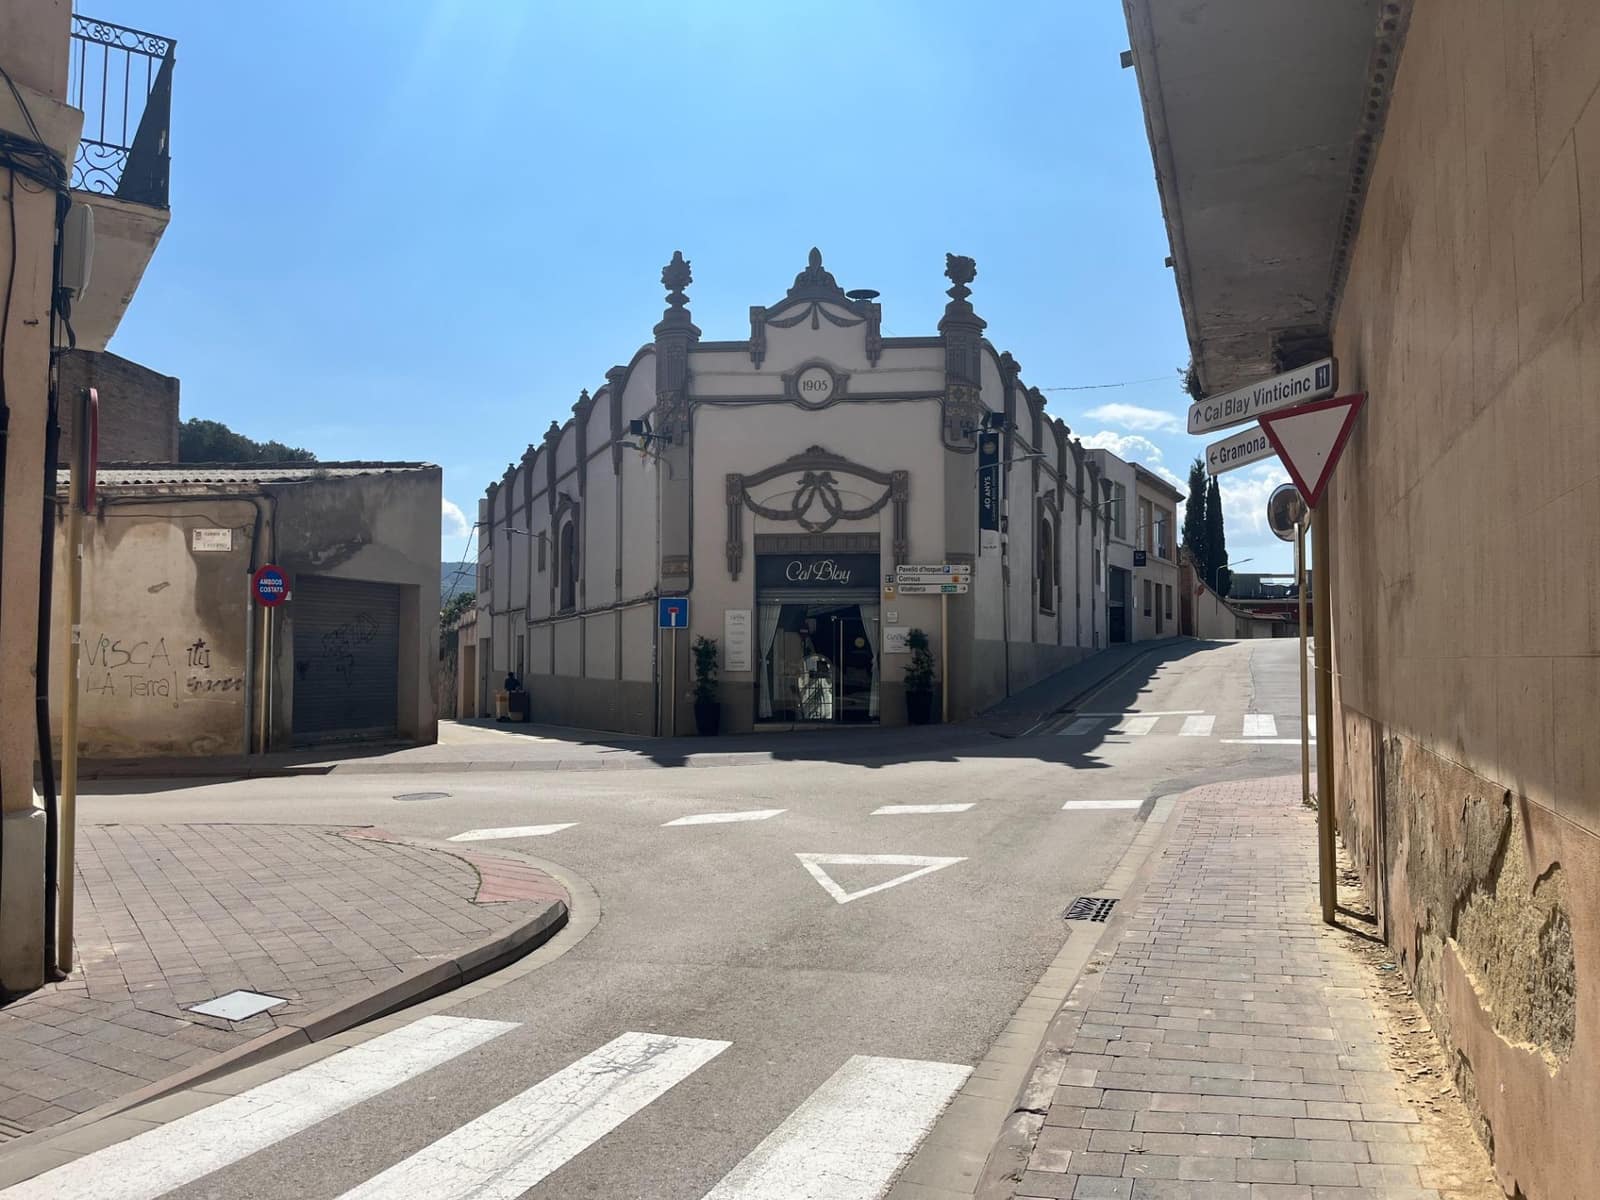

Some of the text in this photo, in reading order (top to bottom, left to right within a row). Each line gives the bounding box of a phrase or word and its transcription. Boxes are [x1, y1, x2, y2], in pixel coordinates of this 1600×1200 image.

[803, 380, 828, 391] 1905
[1204, 378, 1311, 422] Cal Blay Vinticinc
[1219, 436, 1266, 464] Gramona
[984, 497, 991, 510] 40
[786, 559, 851, 584] Cal Blay
